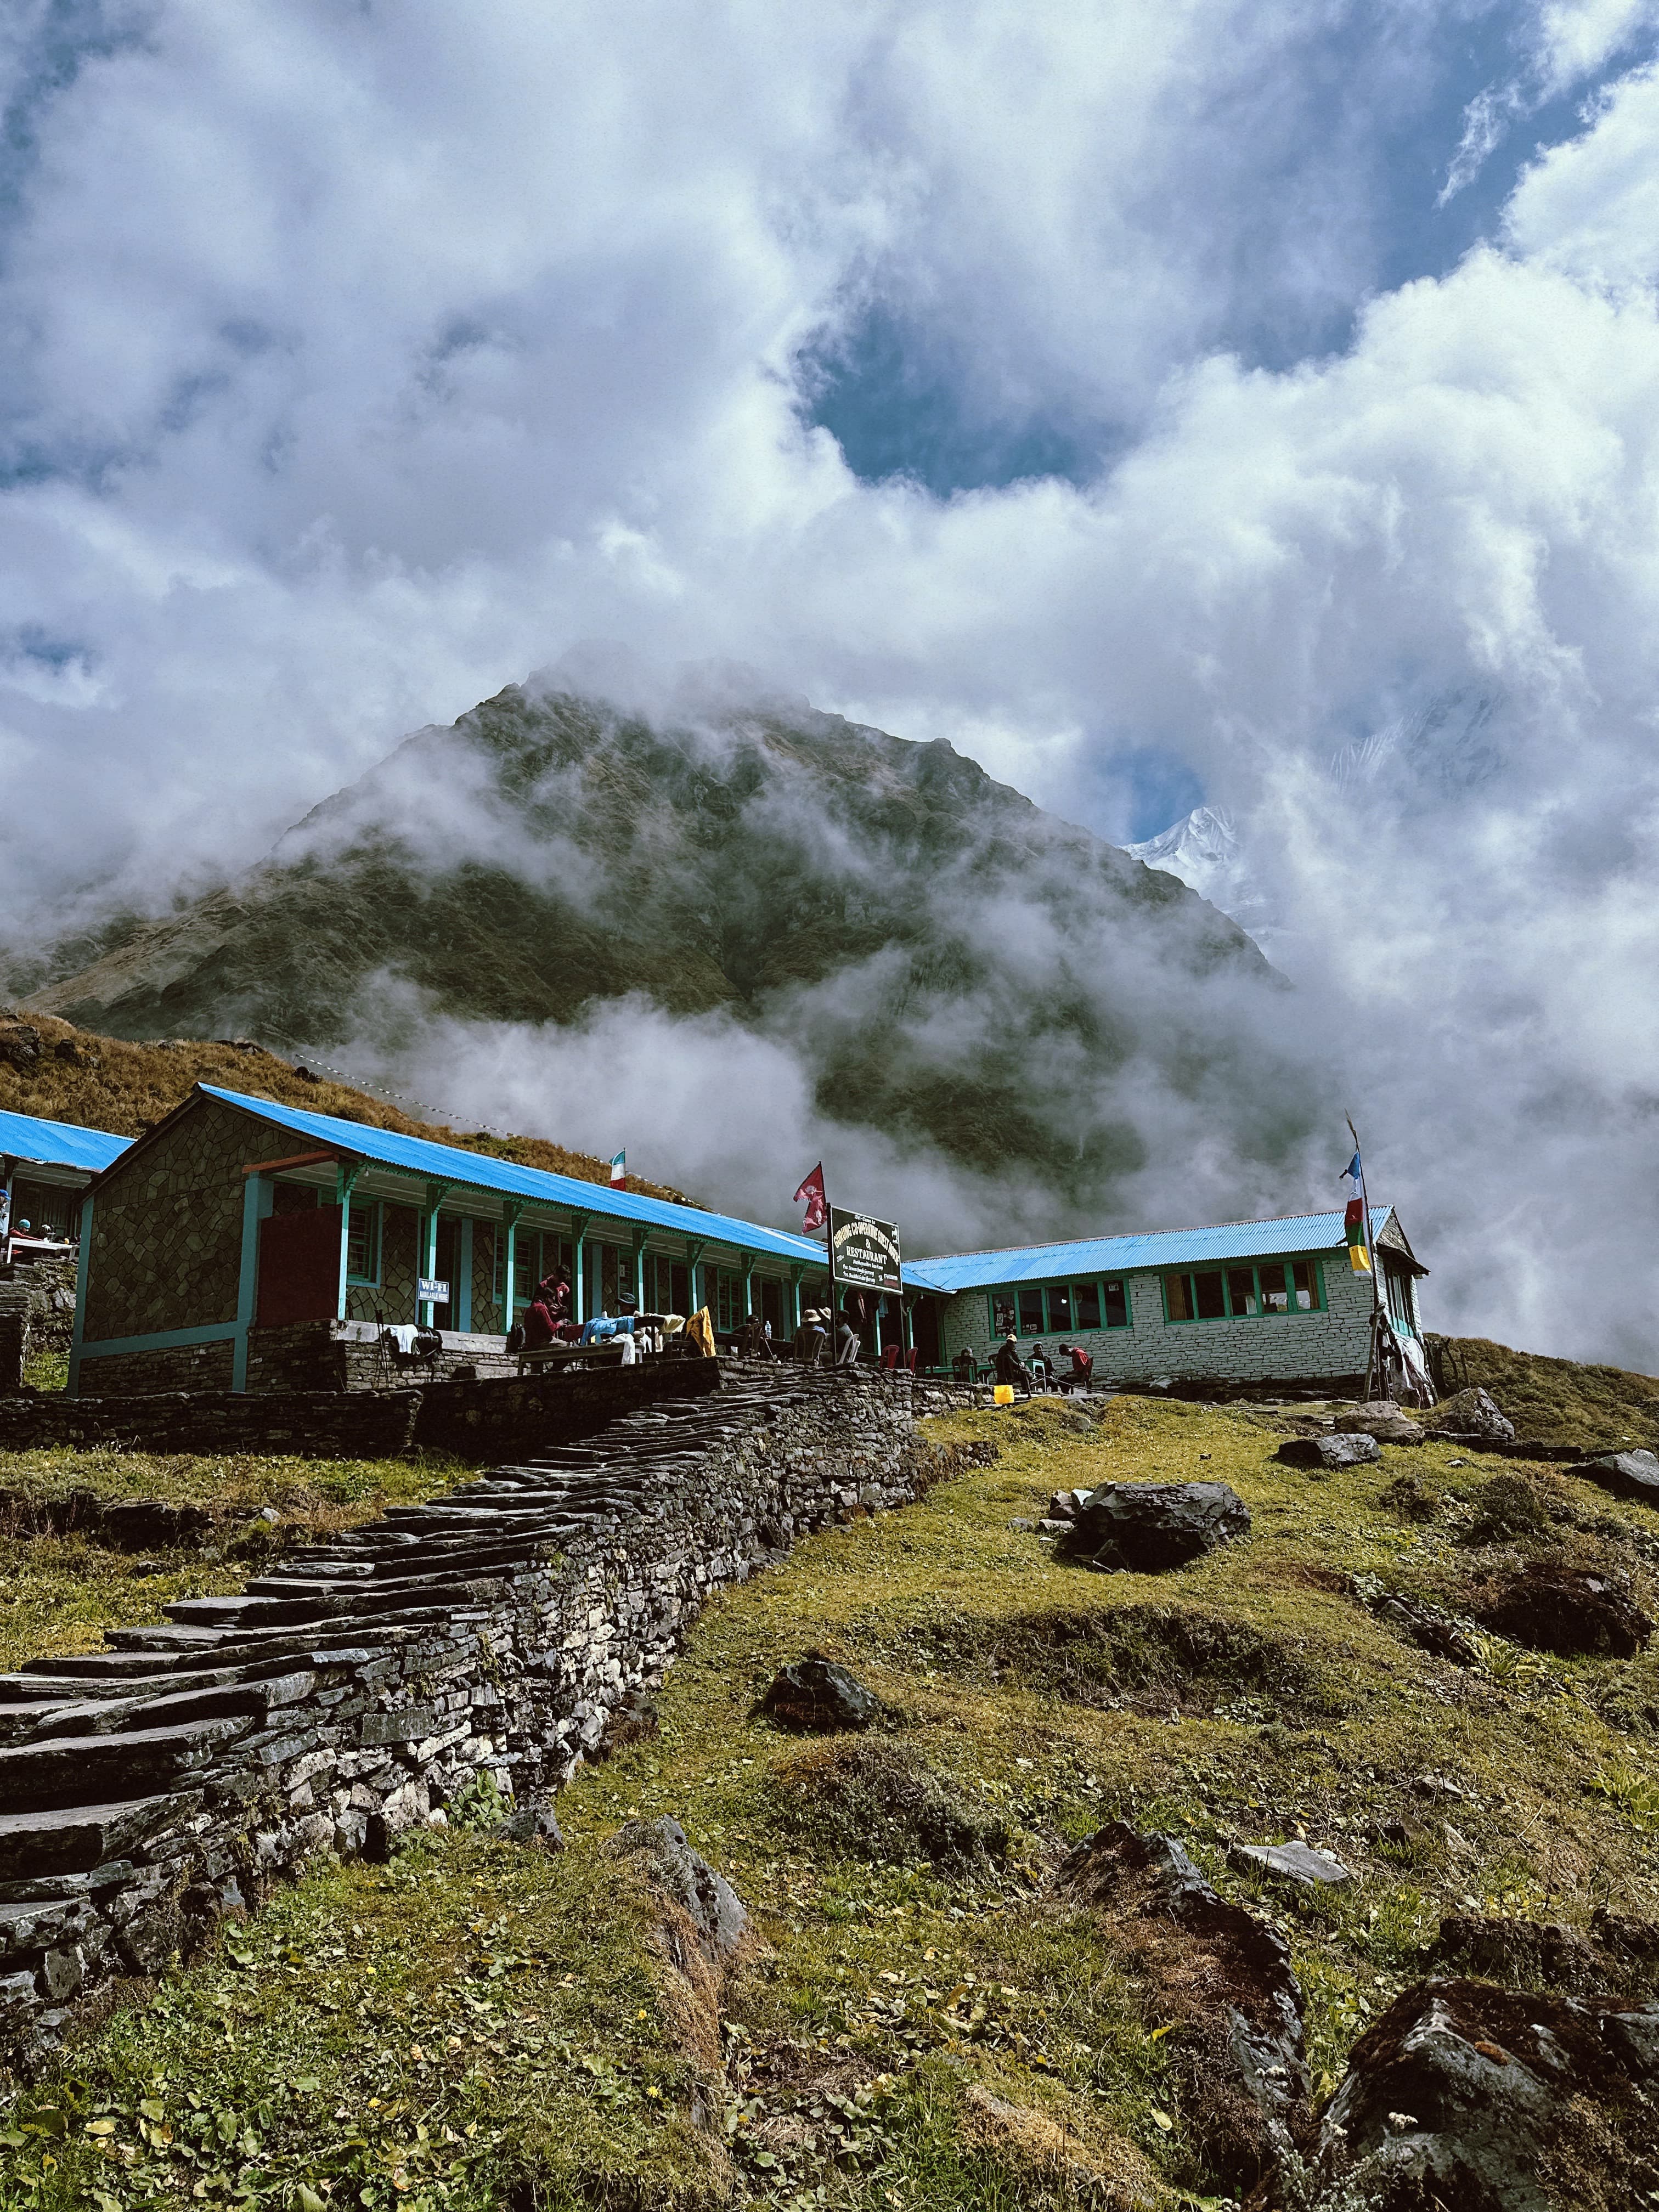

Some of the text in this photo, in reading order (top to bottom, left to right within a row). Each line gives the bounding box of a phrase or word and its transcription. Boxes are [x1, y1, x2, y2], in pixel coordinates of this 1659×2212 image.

[833, 1223, 852, 1249] GURUNG
[851, 1222, 878, 1241] CO-OPERATIVE
[878, 1230, 889, 1251] GUEST
[888, 1242, 899, 1266] HOUSE
[866, 1238, 871, 1250] &
[846, 1245, 887, 1265] RESTAURANT
[421, 1280, 447, 1292] WI-FI
[420, 1290, 438, 1300] AVAILABLE
